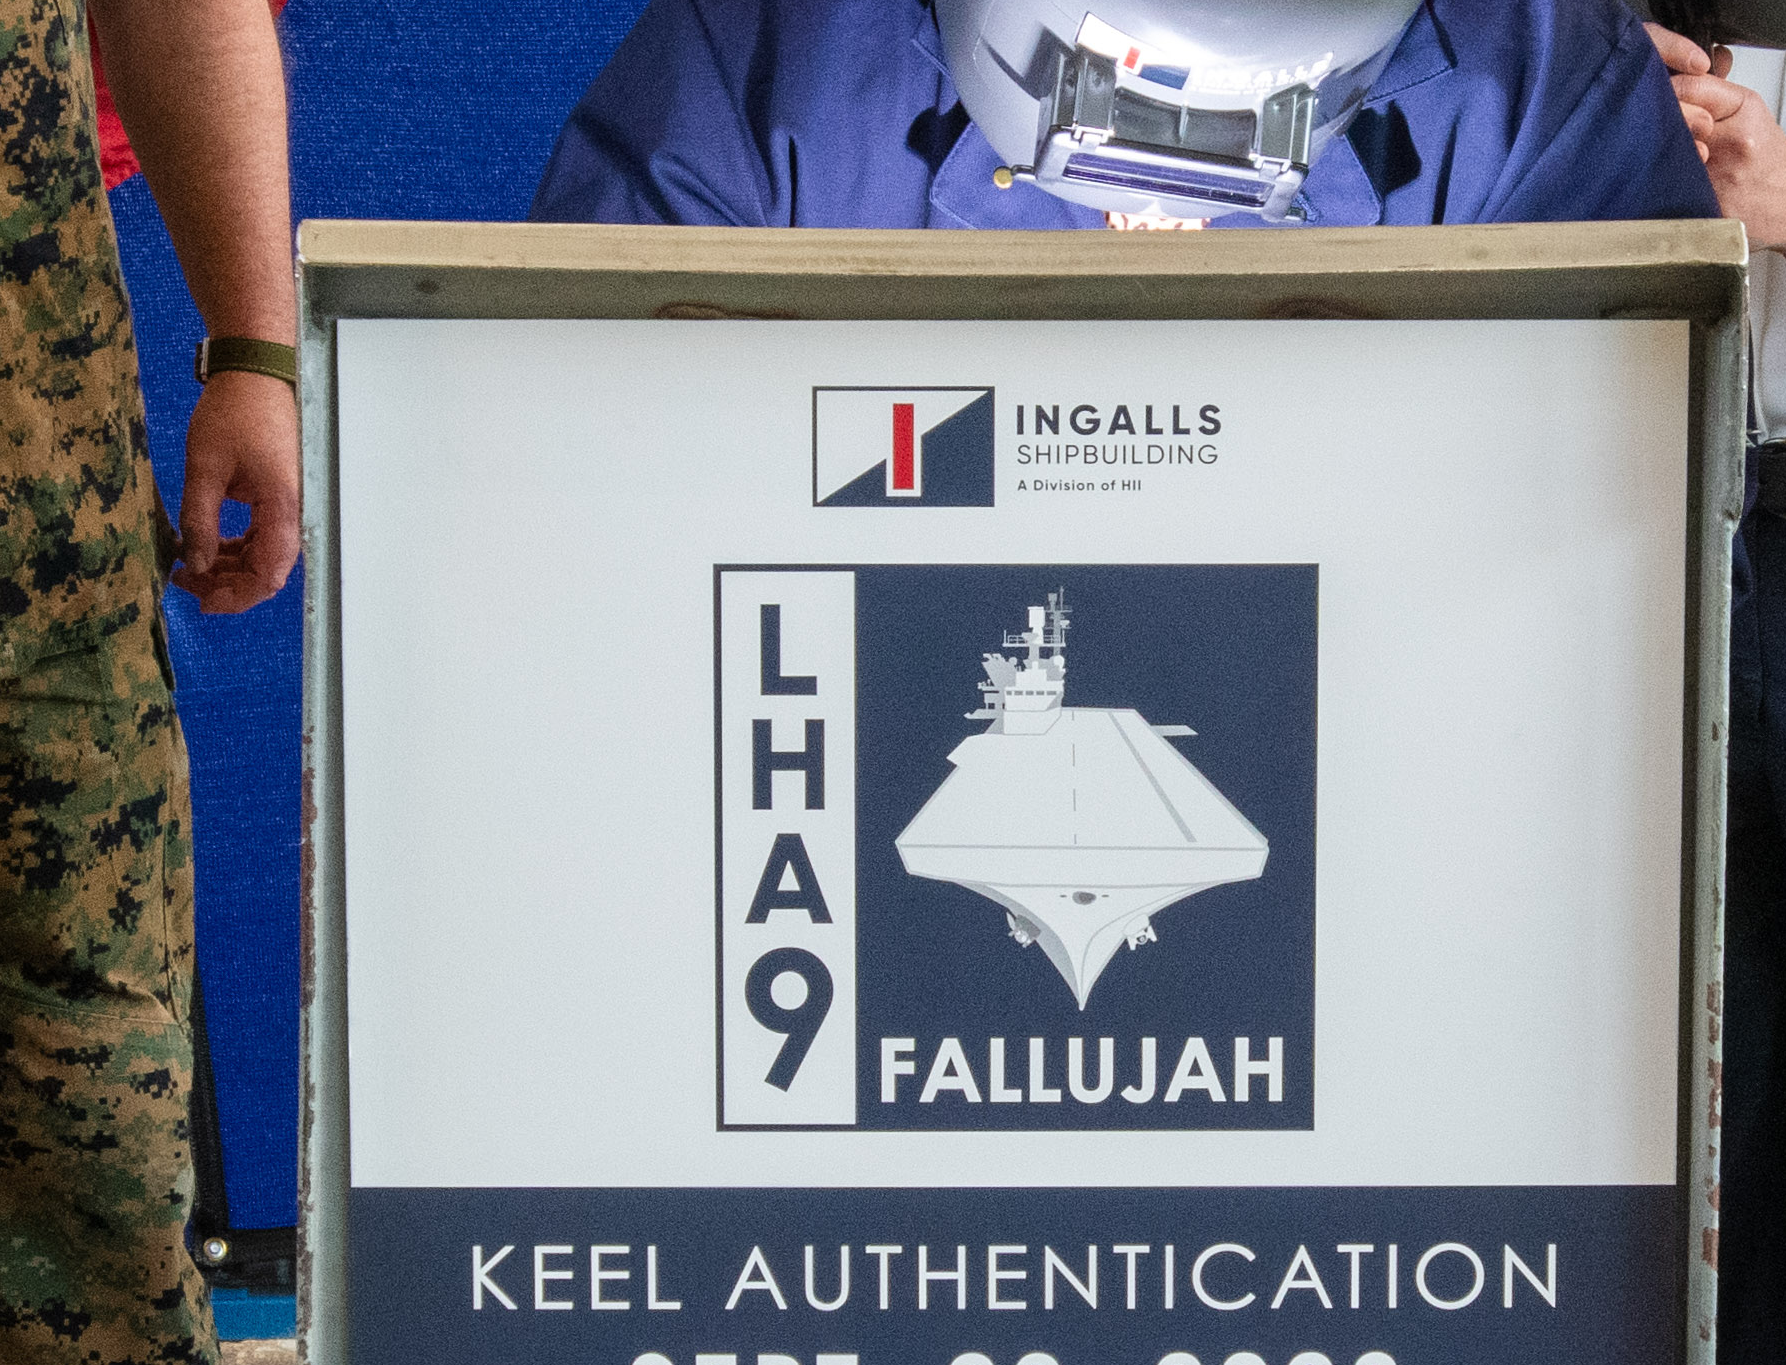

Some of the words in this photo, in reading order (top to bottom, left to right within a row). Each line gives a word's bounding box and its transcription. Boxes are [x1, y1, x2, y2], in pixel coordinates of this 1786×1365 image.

[1016, 404, 1222, 435] INGALLS
[1017, 444, 1219, 464] SHIPBUILDING
[1017, 480, 1027, 491] A
[1033, 479, 1095, 491] Division
[1101, 479, 1116, 491] of
[744, 603, 835, 1093] LHA9
[880, 1036, 1285, 1105] FALLUJAH
[471, 1243, 682, 1311] KEEL
[725, 1240, 1558, 1312] AUTHENTICATION
